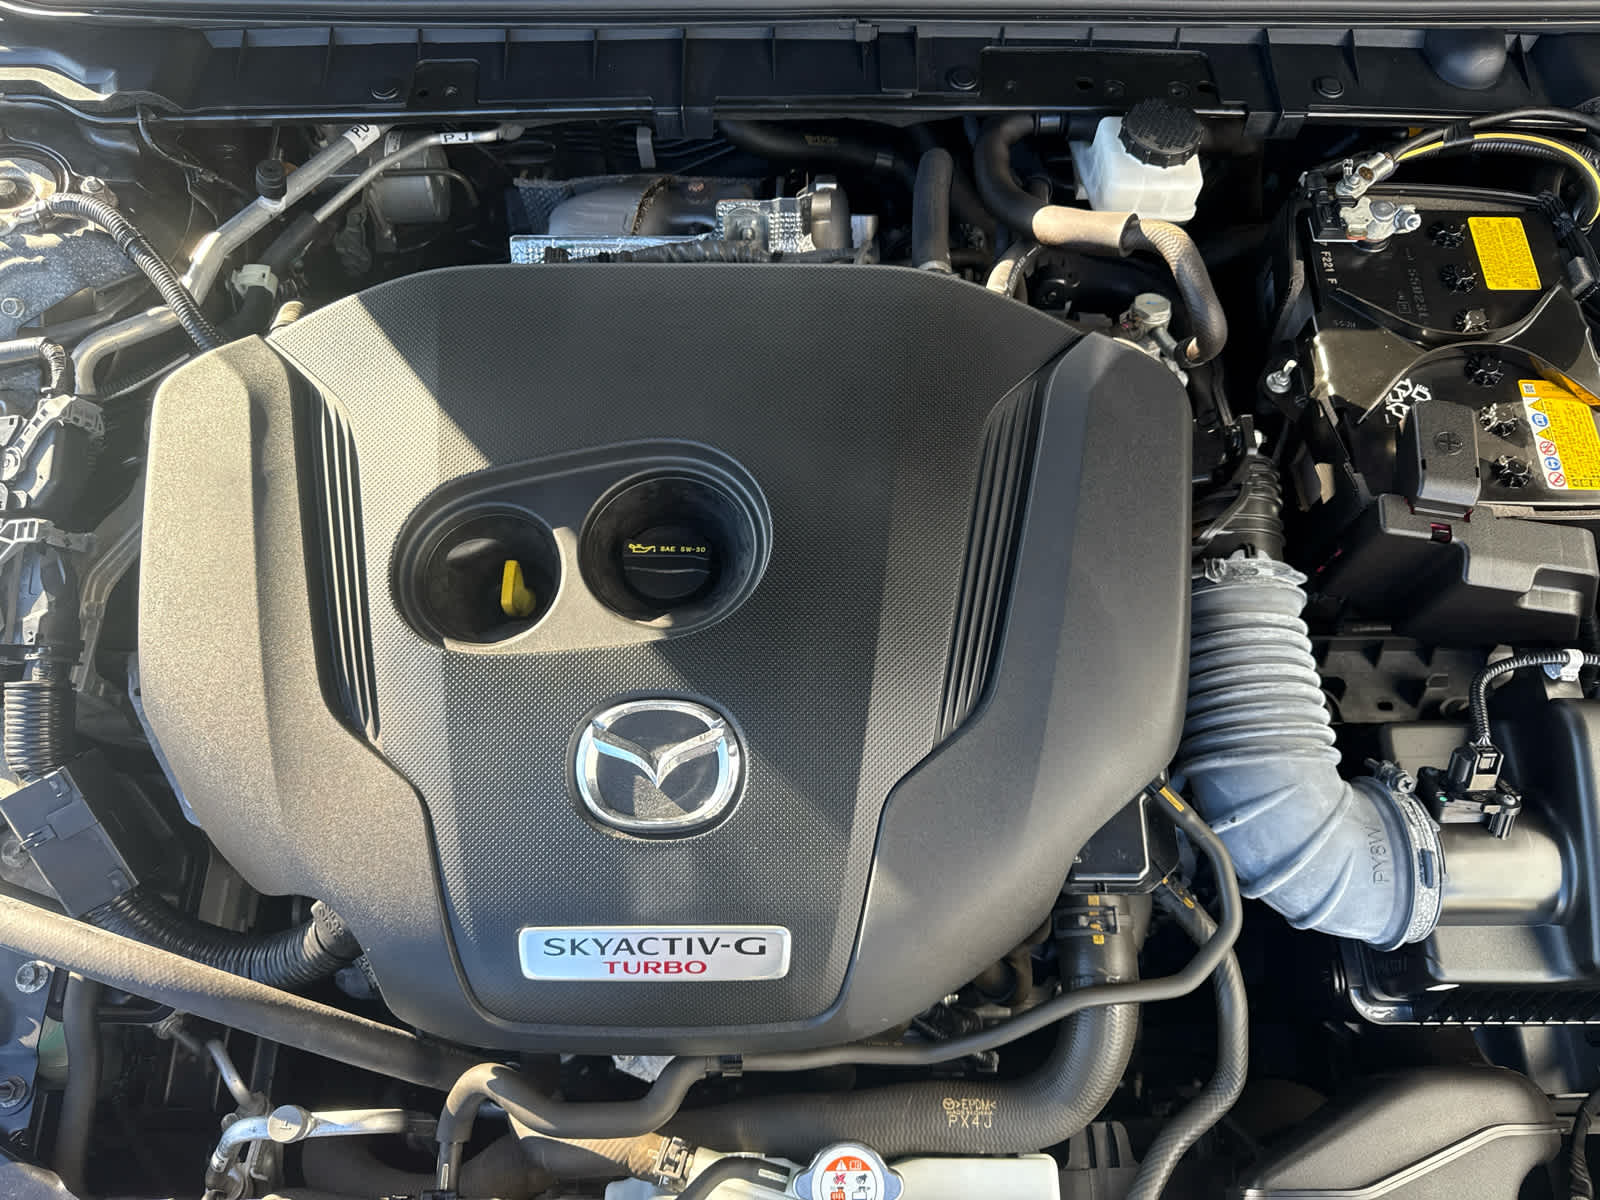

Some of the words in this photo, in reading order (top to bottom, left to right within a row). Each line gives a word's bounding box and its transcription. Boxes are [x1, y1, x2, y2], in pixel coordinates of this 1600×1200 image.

[443, 132, 469, 143] PJ
[1321, 250, 1336, 272] F221
[660, 545, 677, 553] SAE
[680, 545, 706, 553] 5W-30
[543, 936, 767, 957] SKYACTIV-G
[602, 960, 707, 975] TURBO
[948, 1112, 993, 1128] PX4J
